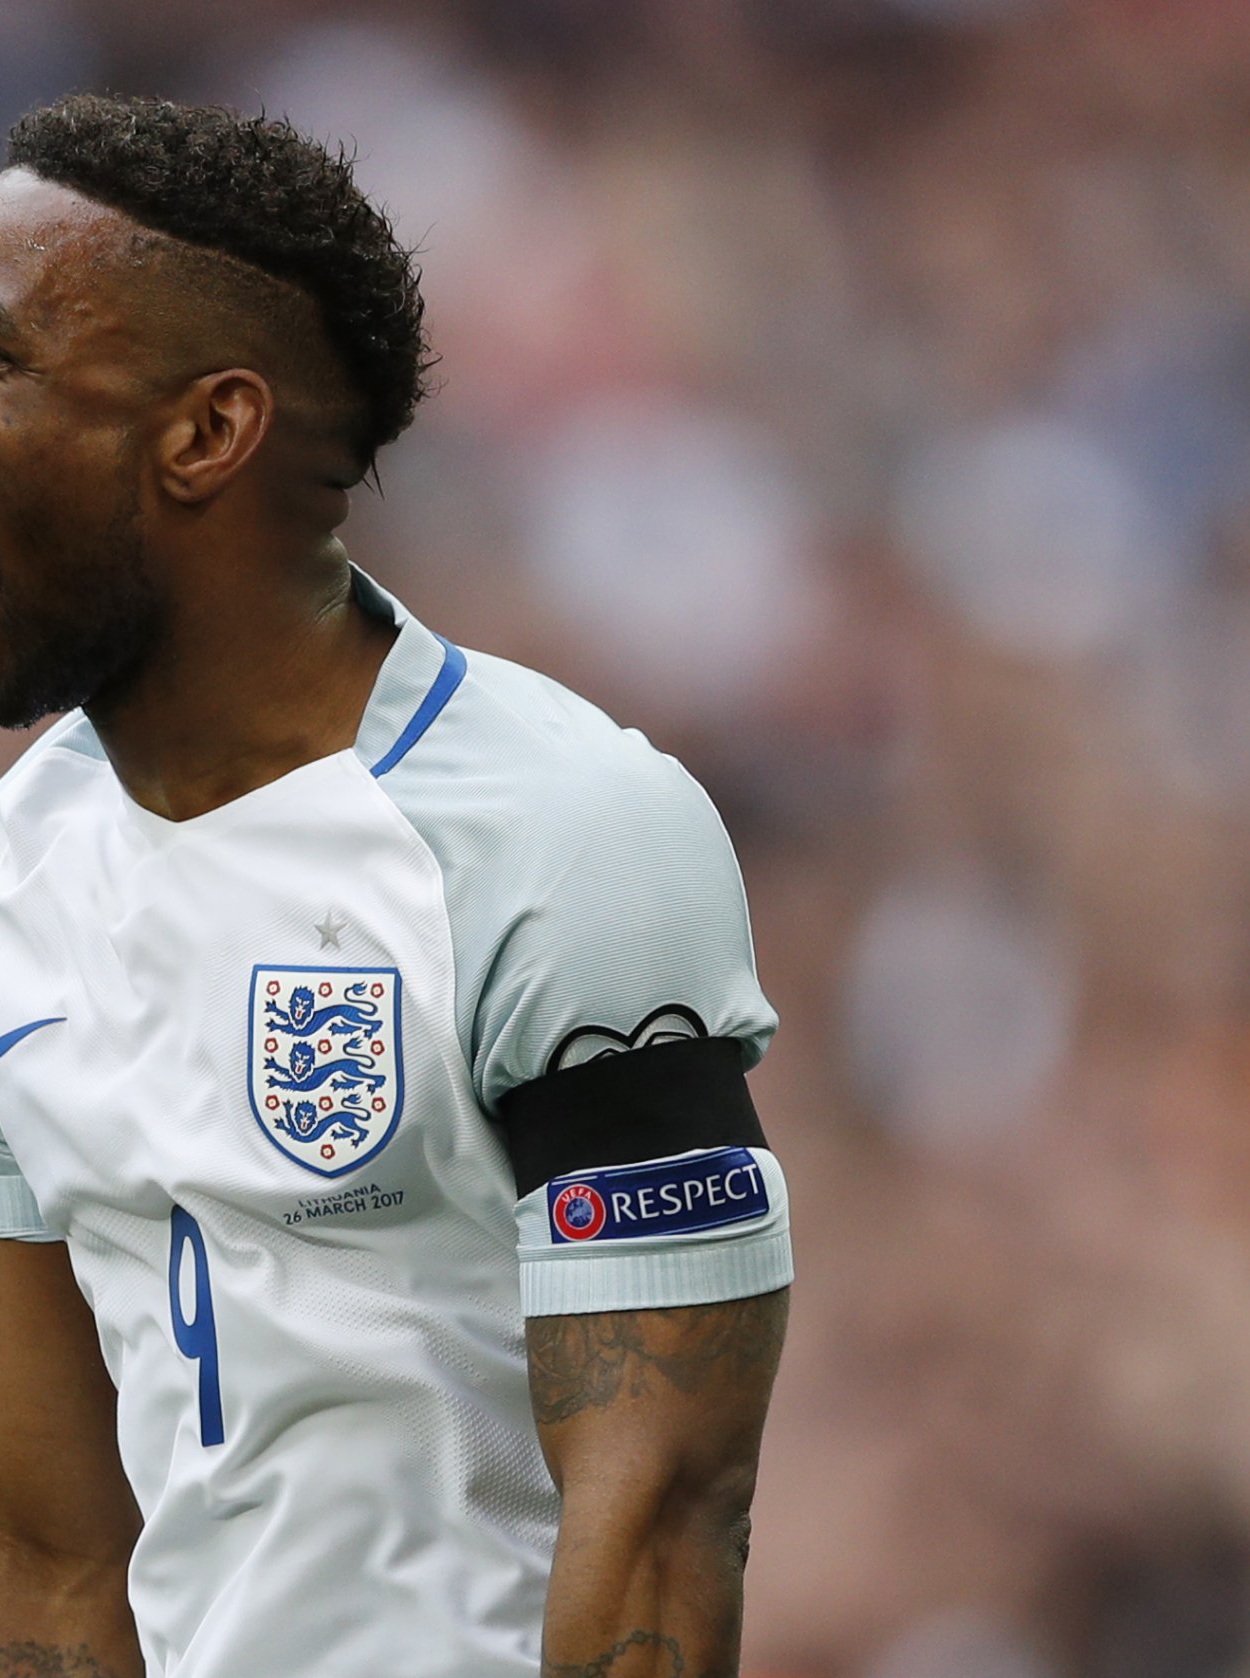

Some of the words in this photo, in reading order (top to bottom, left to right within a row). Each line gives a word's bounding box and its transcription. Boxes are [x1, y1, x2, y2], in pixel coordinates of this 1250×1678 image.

[283, 1212, 302, 1225] 26
[306, 1199, 366, 1218] MARCH
[371, 1191, 404, 1209] 2017
[298, 1183, 381, 1207] LITHUANIA
[561, 1189, 592, 1204] UEFA
[611, 1163, 759, 1223] RESPECT
[169, 1203, 225, 1448] 9
